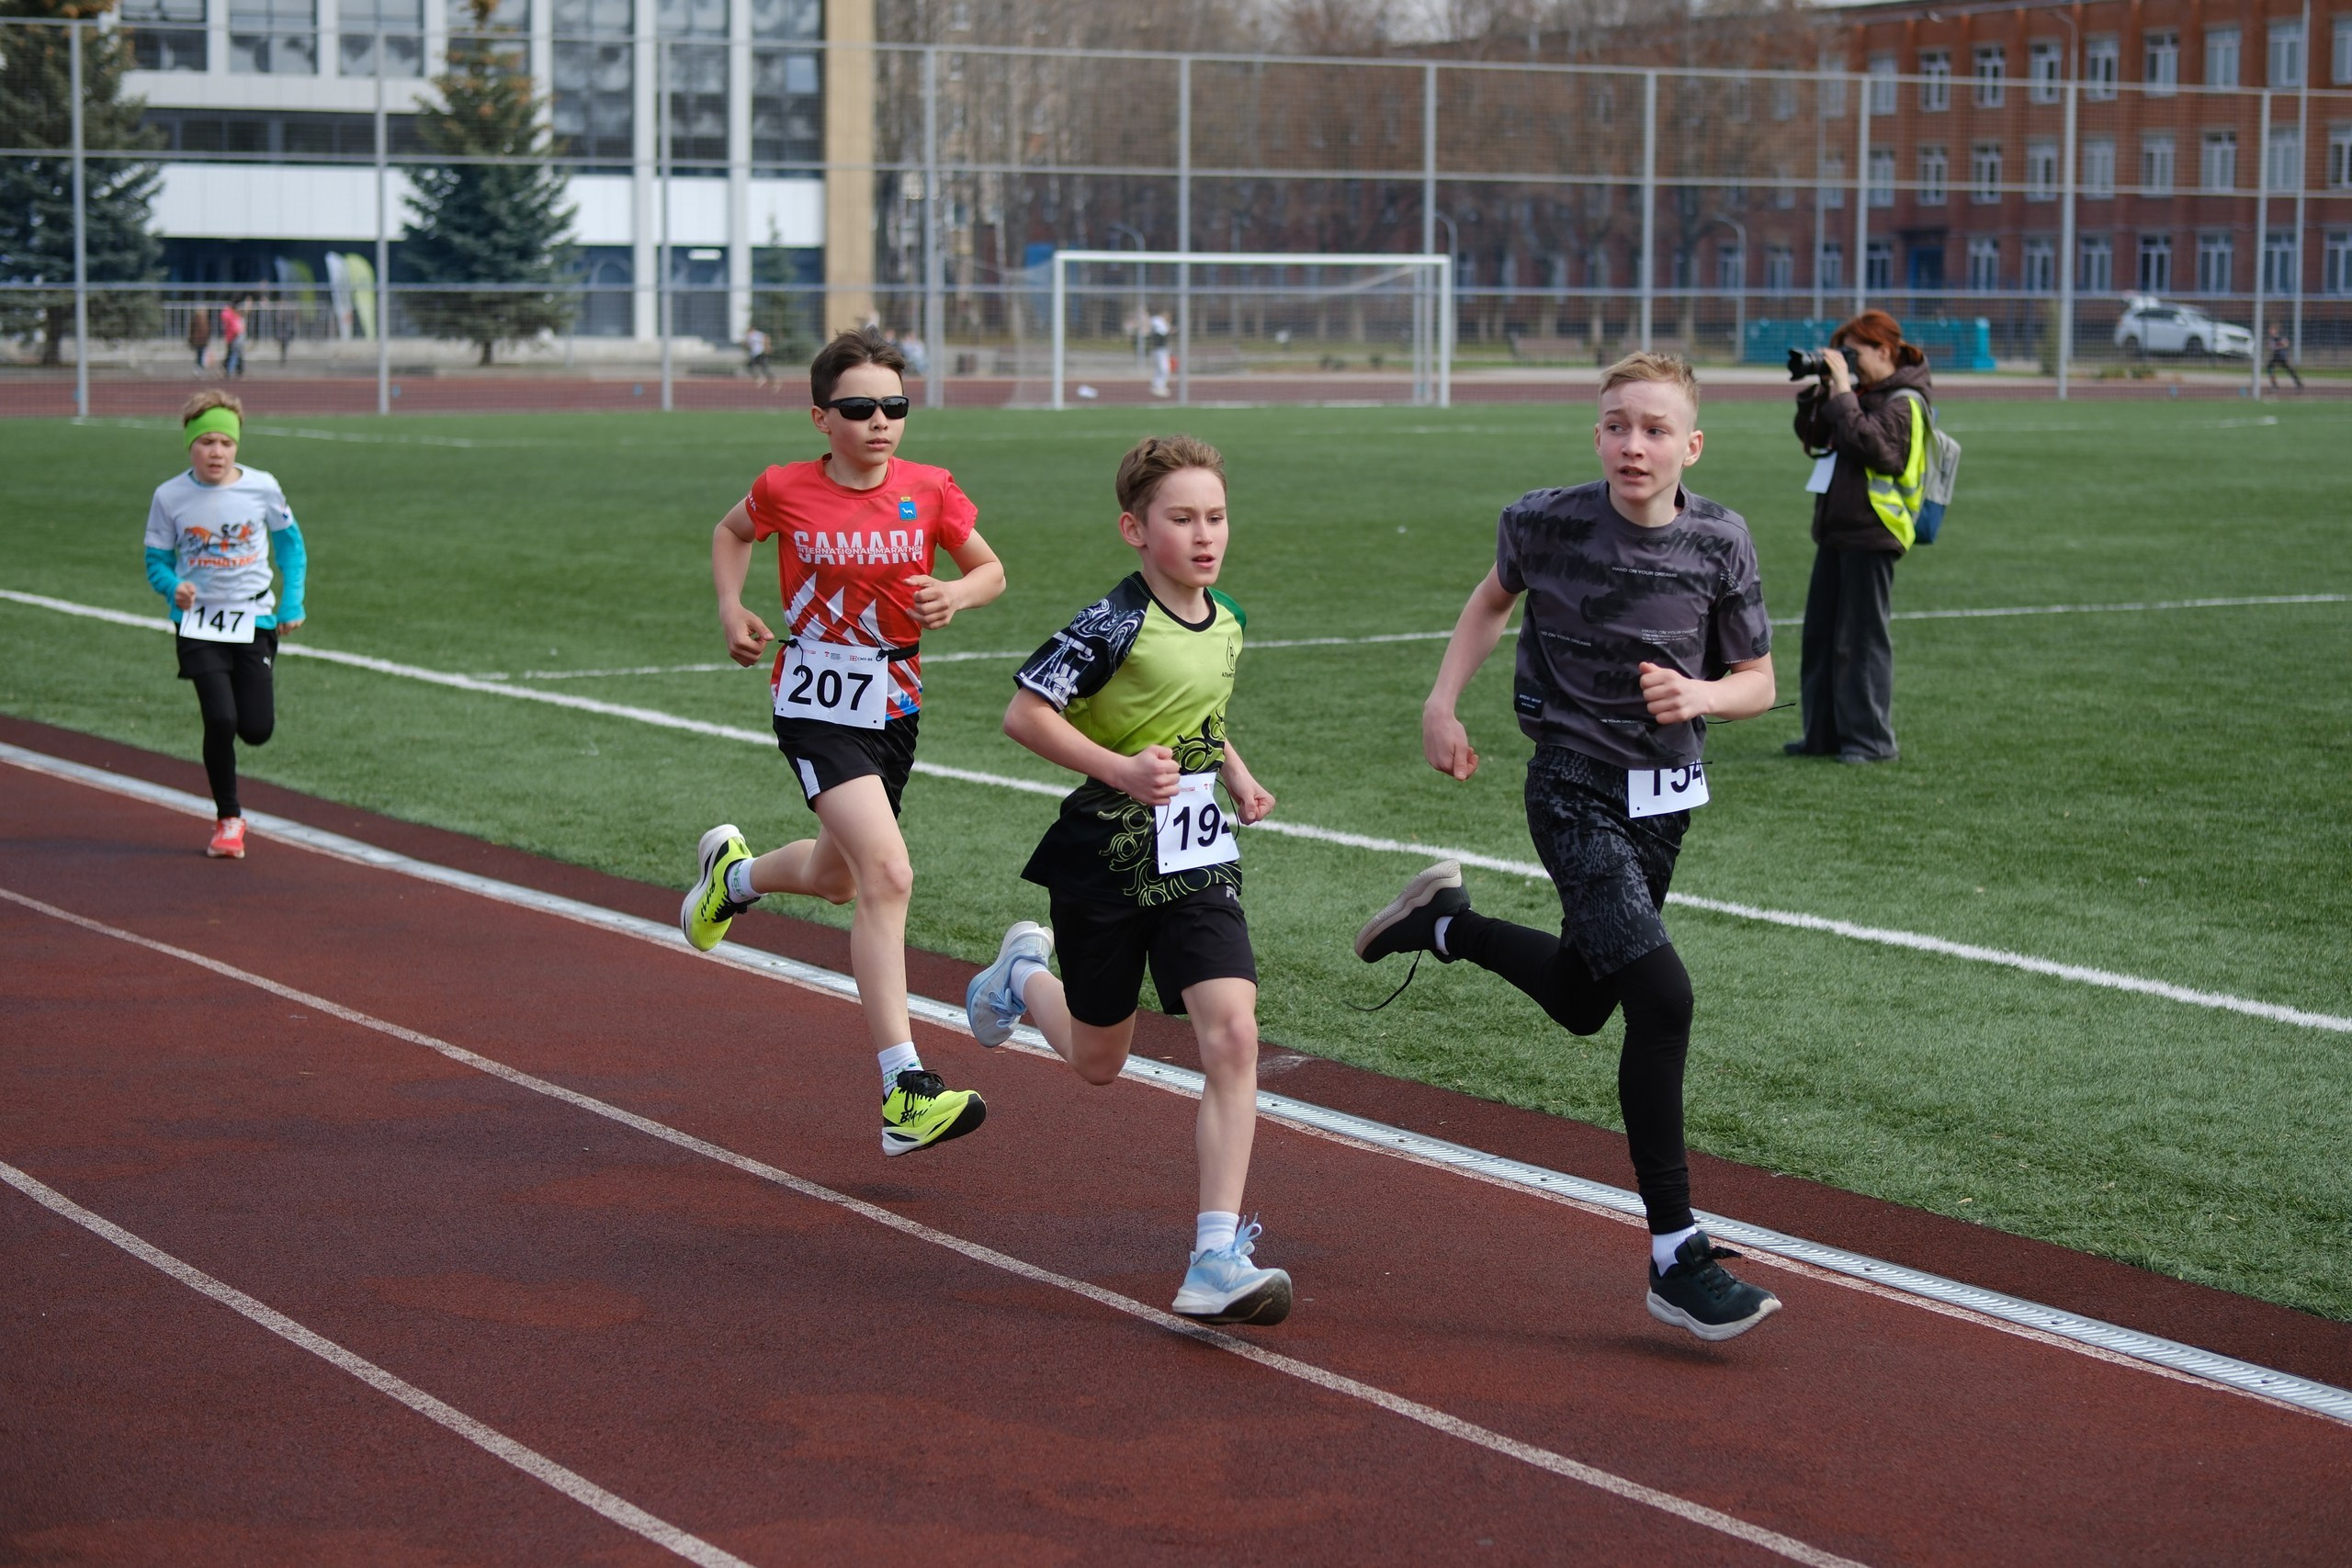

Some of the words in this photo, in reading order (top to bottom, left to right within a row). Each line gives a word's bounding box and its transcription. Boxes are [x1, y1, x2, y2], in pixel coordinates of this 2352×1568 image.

[793, 529, 924, 565] SAMARA
[874, 544, 923, 555] MARATHO
[194, 604, 245, 634] 147
[787, 664, 874, 712] 207
